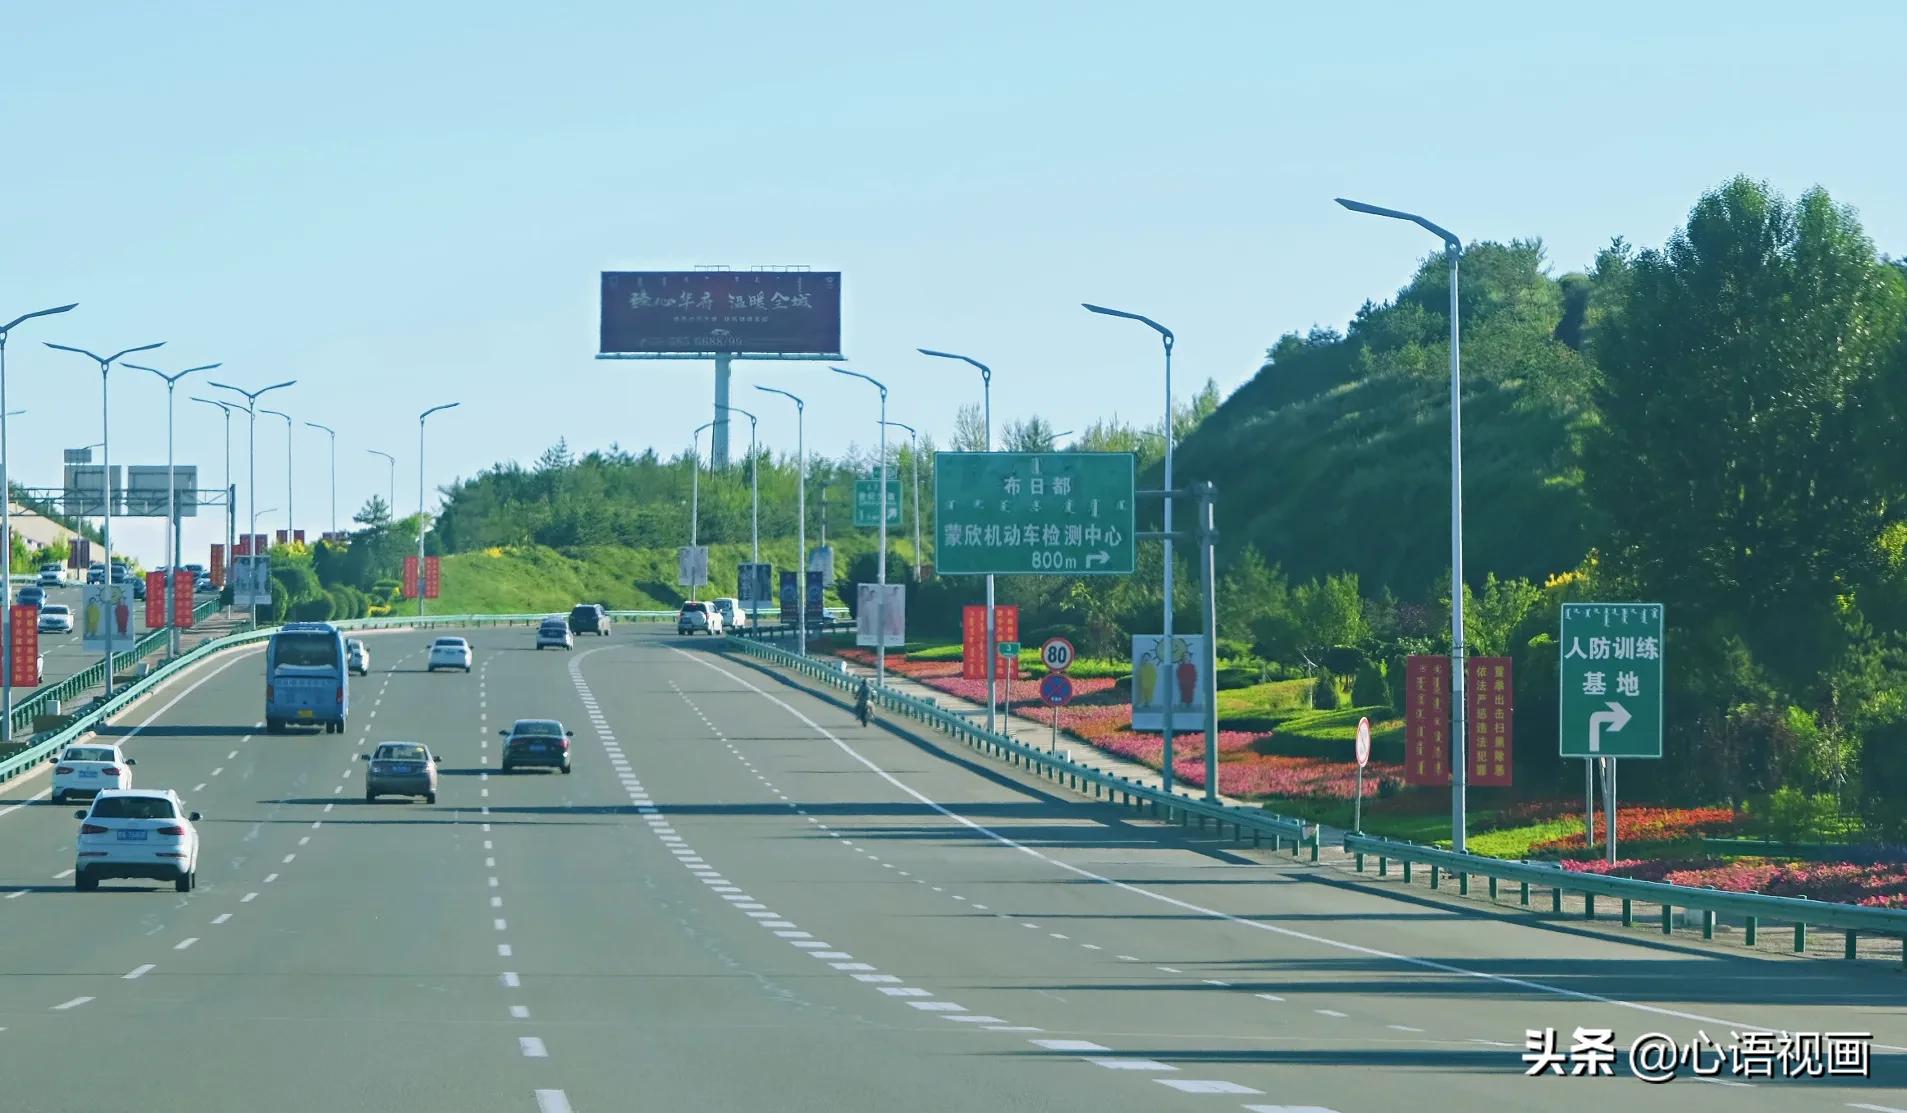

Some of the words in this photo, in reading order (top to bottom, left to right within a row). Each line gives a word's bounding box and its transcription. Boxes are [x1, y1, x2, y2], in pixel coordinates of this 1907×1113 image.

[728, 290, 813, 310] 温暖全城
[1004, 476, 1072, 496] 布日都
[944, 523, 1122, 547] 蒙欣机动车检测中心
[1031, 551, 1077, 569] 800m
[1048, 646, 1067, 663] 80
[1564, 636, 1660, 660] 人防训练
[1582, 671, 1641, 696] 基地
